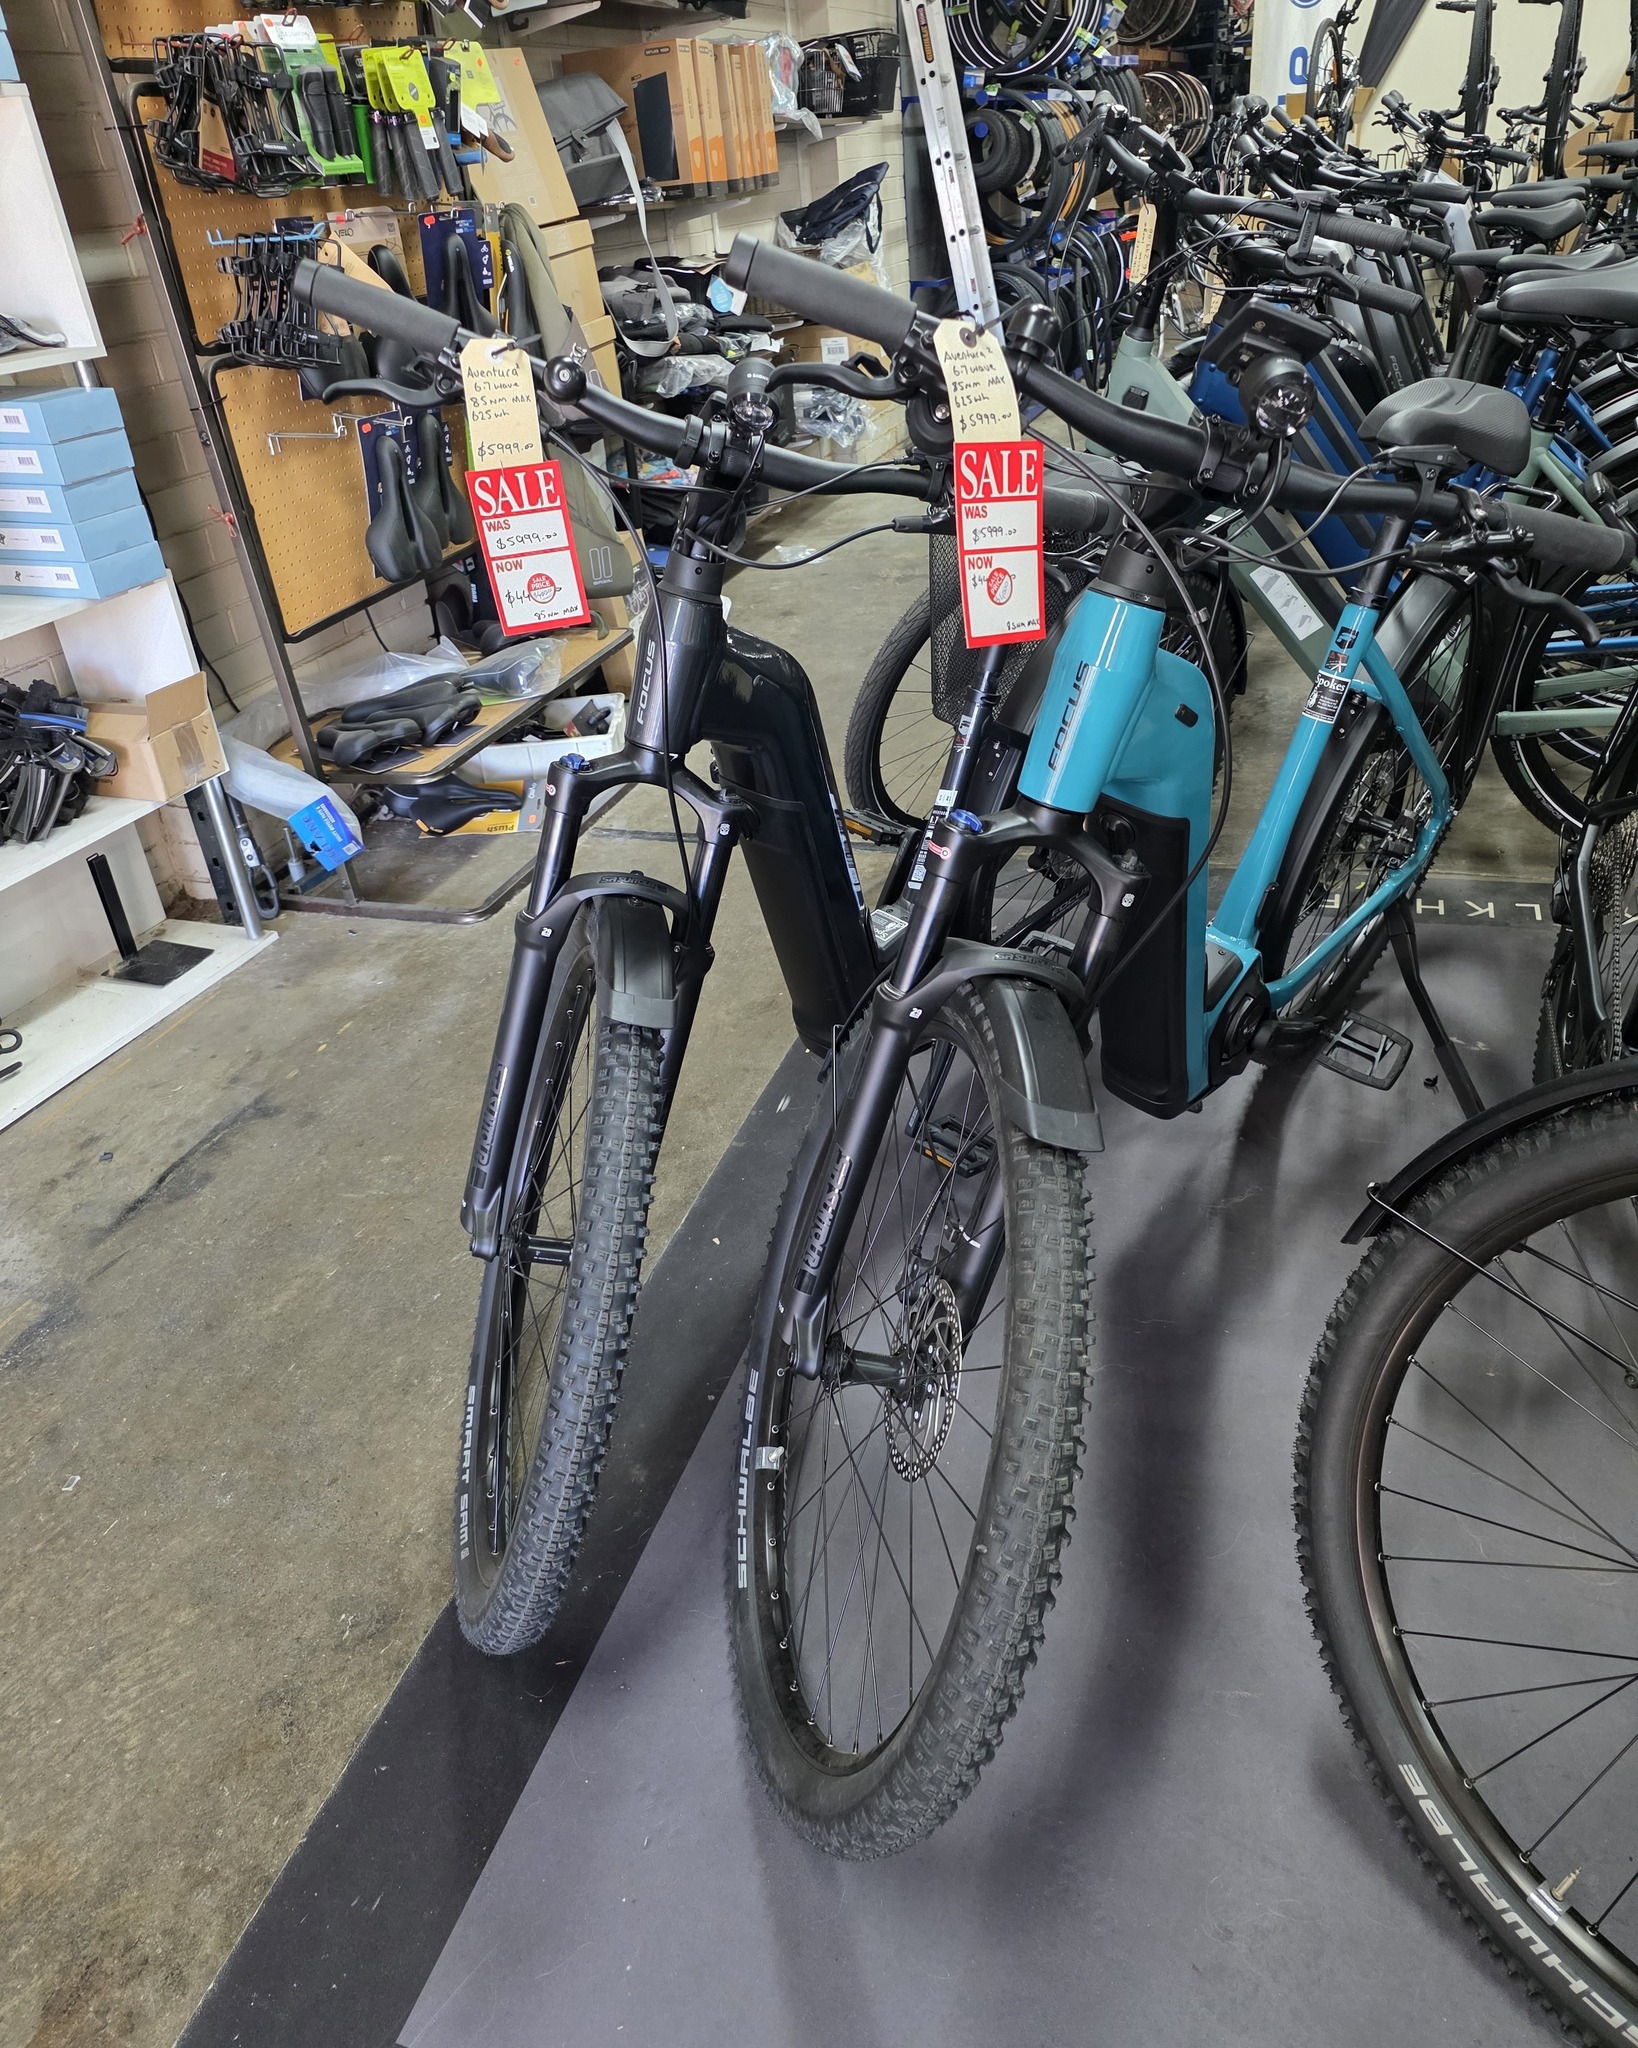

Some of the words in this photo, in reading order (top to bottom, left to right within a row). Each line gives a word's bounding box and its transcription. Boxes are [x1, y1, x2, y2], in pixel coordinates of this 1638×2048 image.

[334, 228, 354, 239] VELO
[1302, 221, 1313, 248] MAGURA
[944, 350, 986, 363] Aventura
[960, 449, 1038, 499] SALE
[474, 468, 561, 517] SALE
[964, 505, 988, 519] WAS
[485, 519, 511, 532] WAS
[495, 560, 523, 573] NOW
[968, 556, 993, 570] NOW
[531, 580, 551, 590] PRICE
[532, 575, 547, 584] SALE
[988, 570, 999, 588] SALE
[990, 572, 1005, 595] PRICE
[636, 640, 656, 726] FOCUS
[1316, 674, 1346, 692] Spokes
[1048, 659, 1089, 771] FOCUS
[1509, 740, 1521, 761] PLUS
[1532, 789, 1564, 821] SCHWALBE
[487, 824, 514, 833] Plush
[462, 1384, 477, 1484] SMART
[736, 1367, 761, 1589] SCHWALBE
[461, 1493, 470, 1546] SAM
